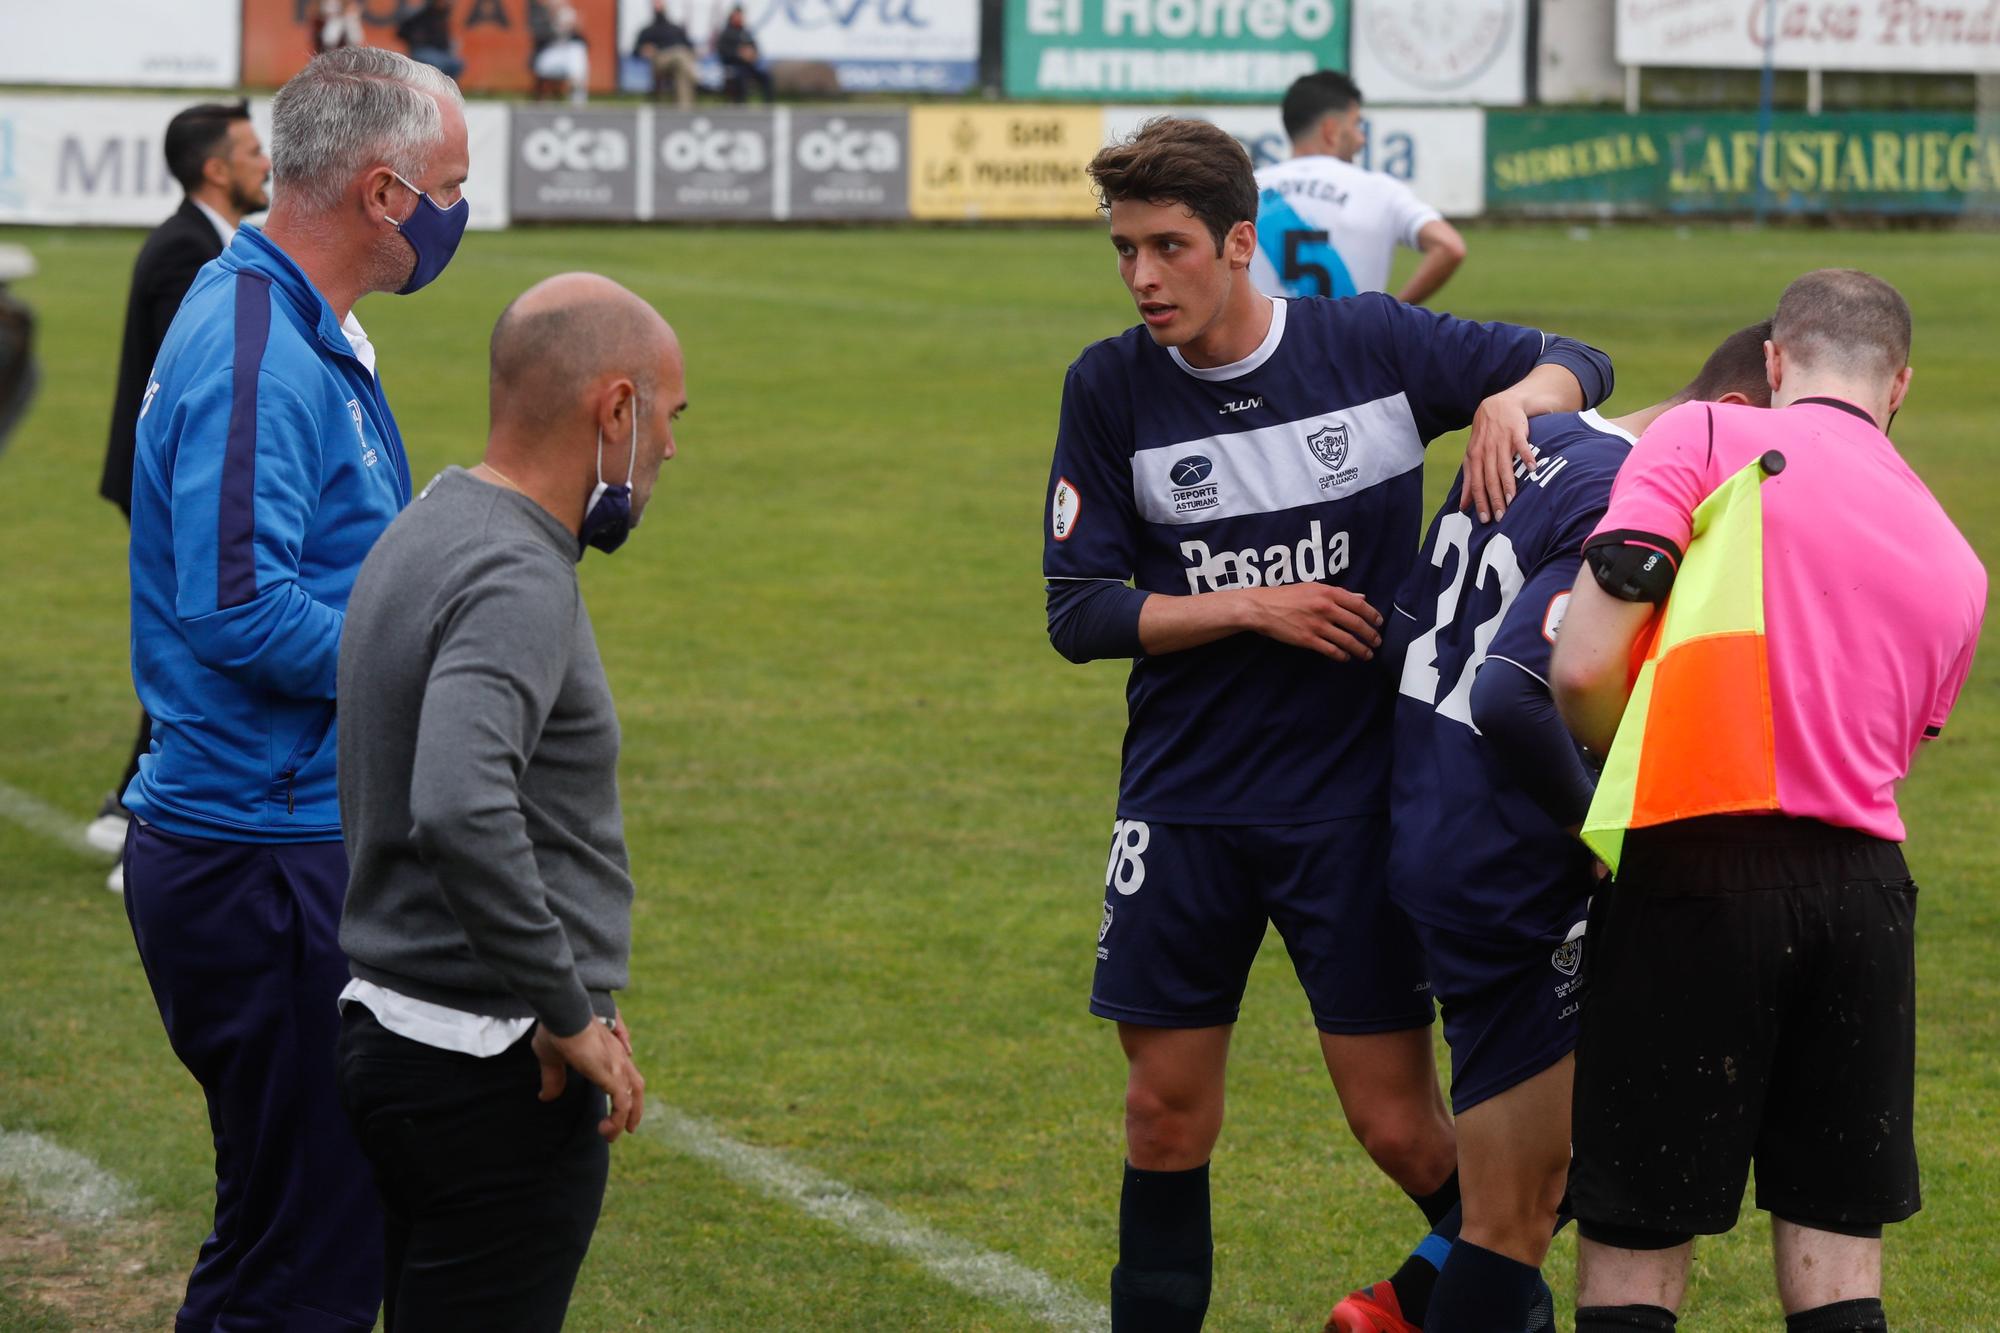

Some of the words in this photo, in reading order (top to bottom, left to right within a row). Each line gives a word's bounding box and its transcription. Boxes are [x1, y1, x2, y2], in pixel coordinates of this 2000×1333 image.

[1284, 229, 1334, 298] 5
[1173, 486, 1218, 502] DEPORTE
[1175, 496, 1219, 511] ASTURIANO
